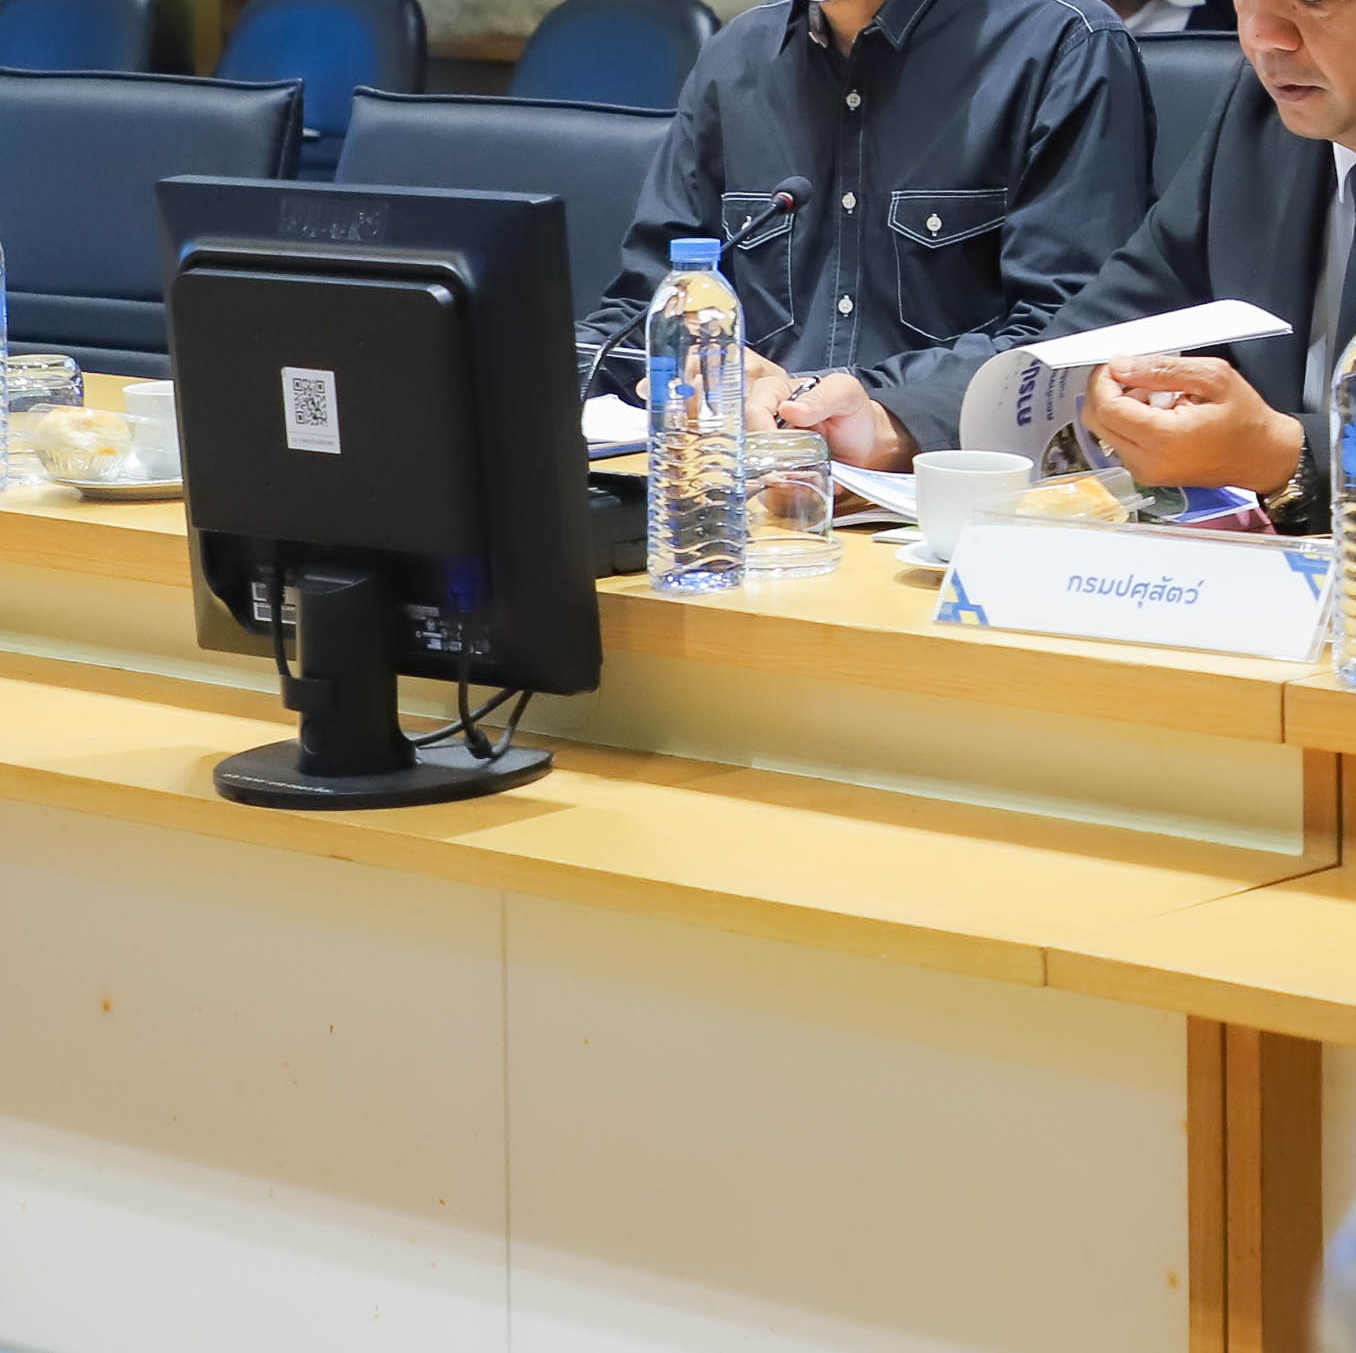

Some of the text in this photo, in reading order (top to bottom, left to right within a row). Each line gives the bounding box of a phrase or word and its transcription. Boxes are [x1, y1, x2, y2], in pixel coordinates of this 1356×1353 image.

[1066, 573, 1205, 609] กรมปศุสัตว์
